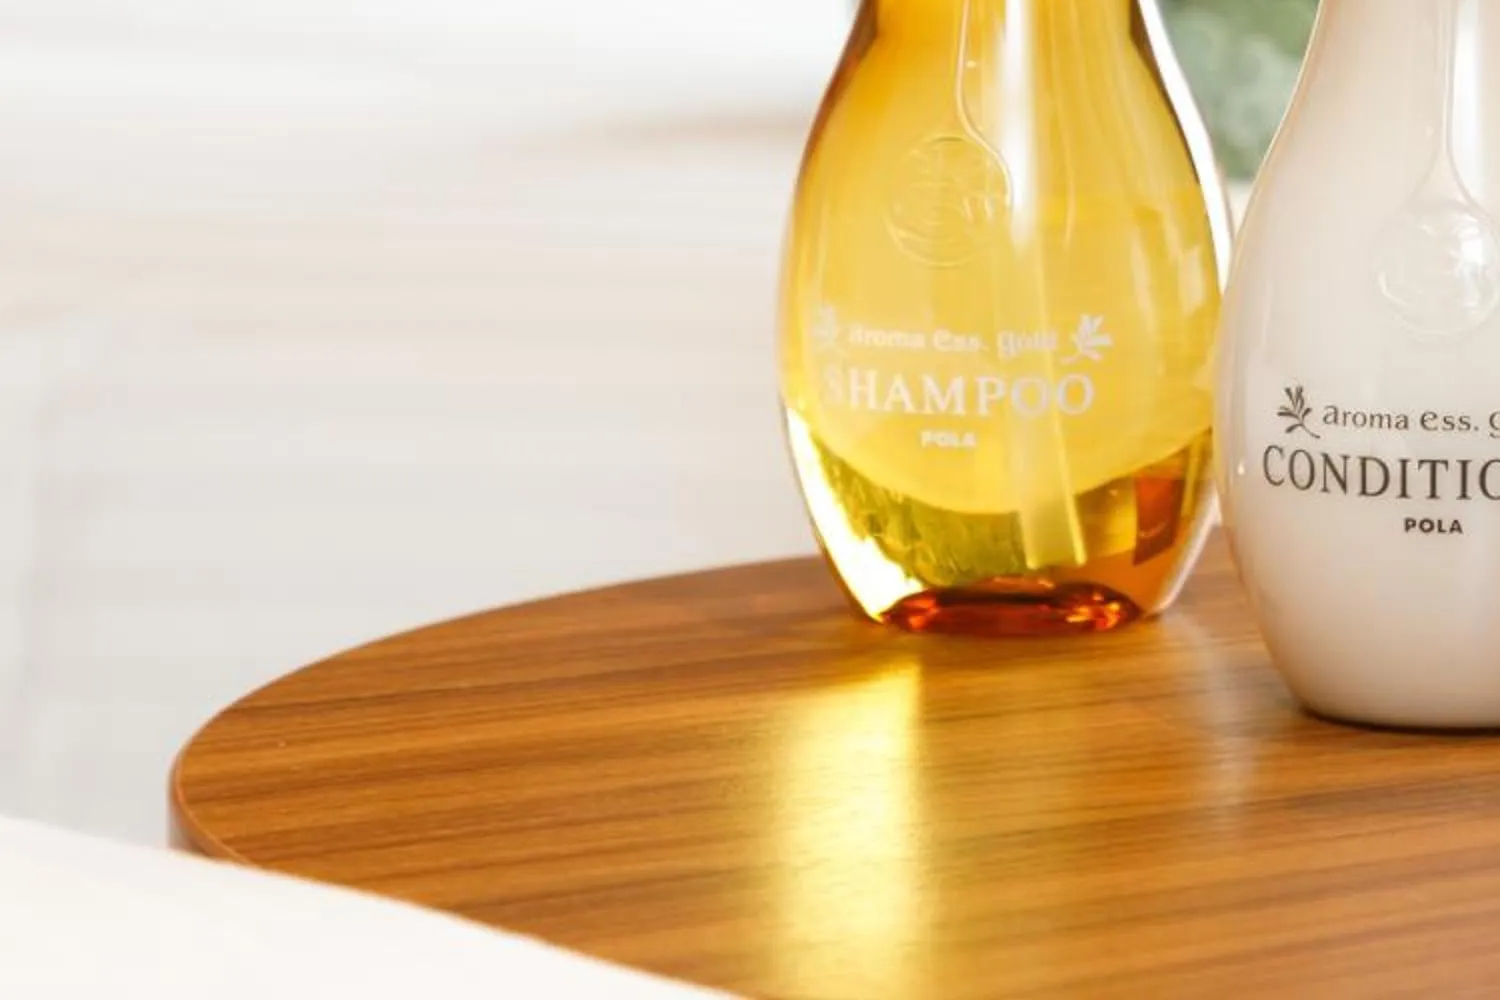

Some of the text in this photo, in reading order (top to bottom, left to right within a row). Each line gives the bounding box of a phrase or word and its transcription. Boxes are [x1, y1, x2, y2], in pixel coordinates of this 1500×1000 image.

[848, 325, 925, 349] aroma
[823, 364, 1095, 417] SHAMPOO
[1322, 405, 1410, 431] aroma
[1420, 410, 1480, 432] ess.
[921, 430, 977, 448] POLA
[1404, 517, 1463, 535] POLA
